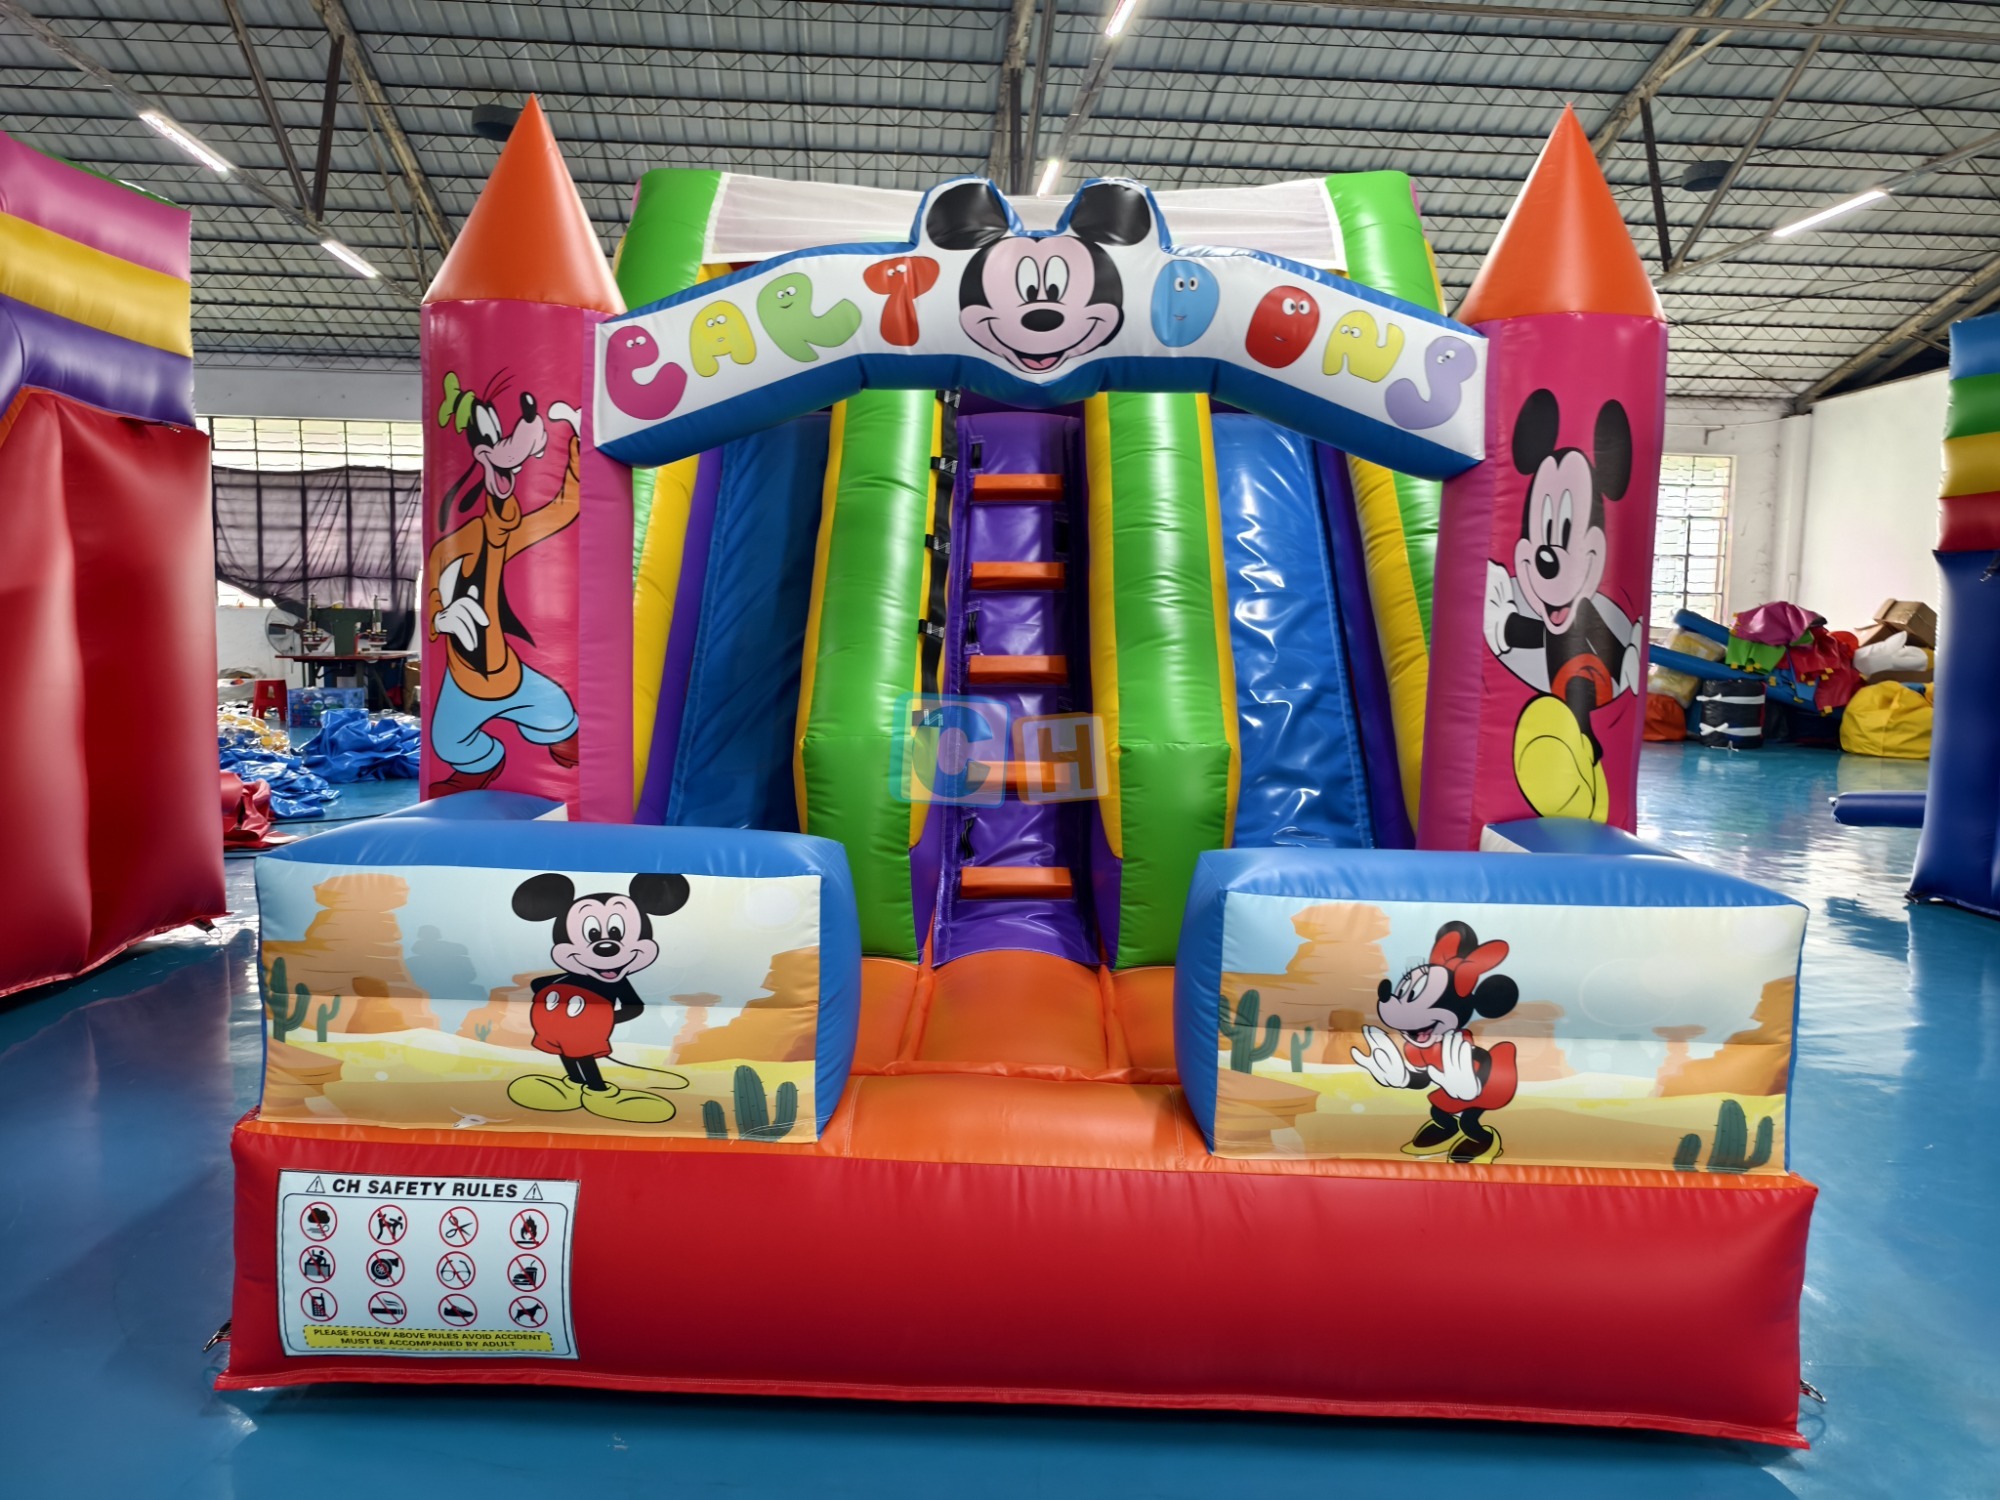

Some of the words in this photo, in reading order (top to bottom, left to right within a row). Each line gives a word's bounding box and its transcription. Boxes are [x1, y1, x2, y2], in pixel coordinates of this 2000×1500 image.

[332, 1178, 362, 1193] CH
[367, 1180, 446, 1196] SAFETY
[452, 1183, 518, 1198] RULES
[351, 1330, 390, 1338] FOLLOW
[495, 1333, 542, 1341] ACCIDENT
[389, 1339, 462, 1347] ACCOMPANIED
